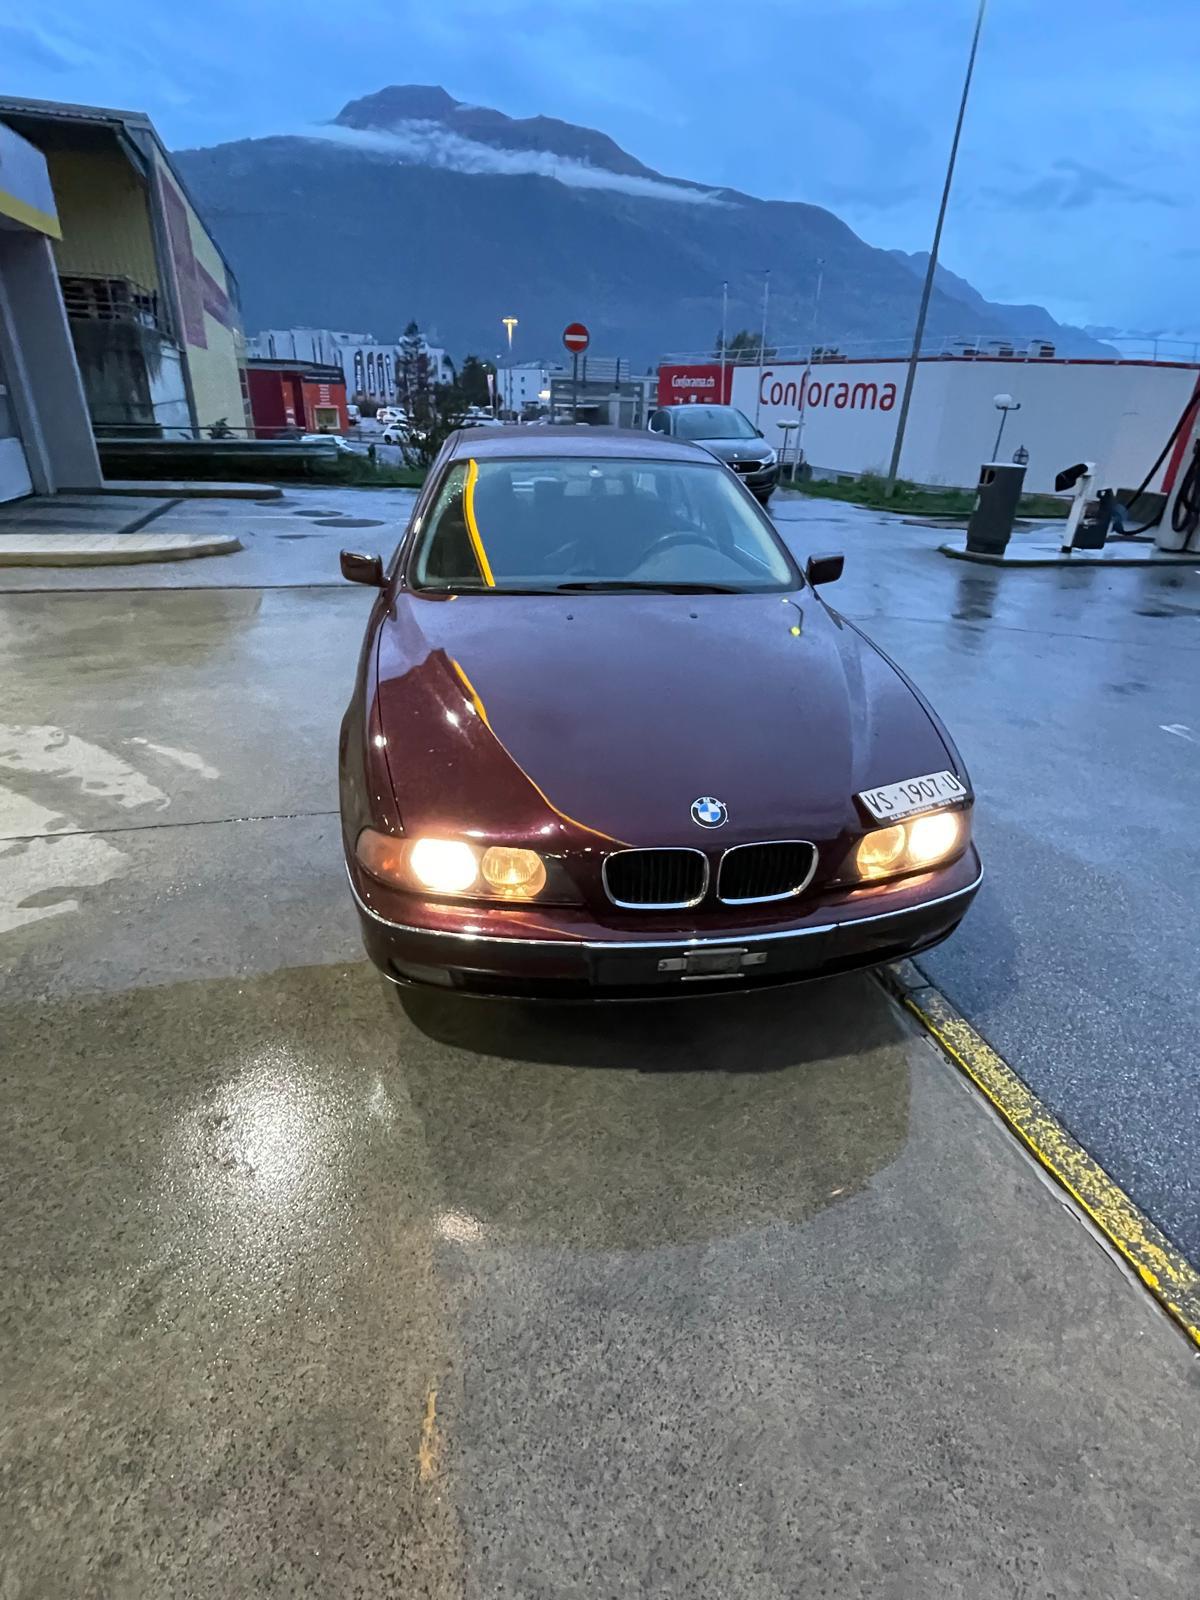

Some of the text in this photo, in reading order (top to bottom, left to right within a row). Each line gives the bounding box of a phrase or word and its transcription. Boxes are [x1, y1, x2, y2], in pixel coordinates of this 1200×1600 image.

[760, 371, 896, 411] Conforama
[864, 791, 894, 813] VS
[899, 778, 942, 804] 1907
[941, 774, 960, 791] U
